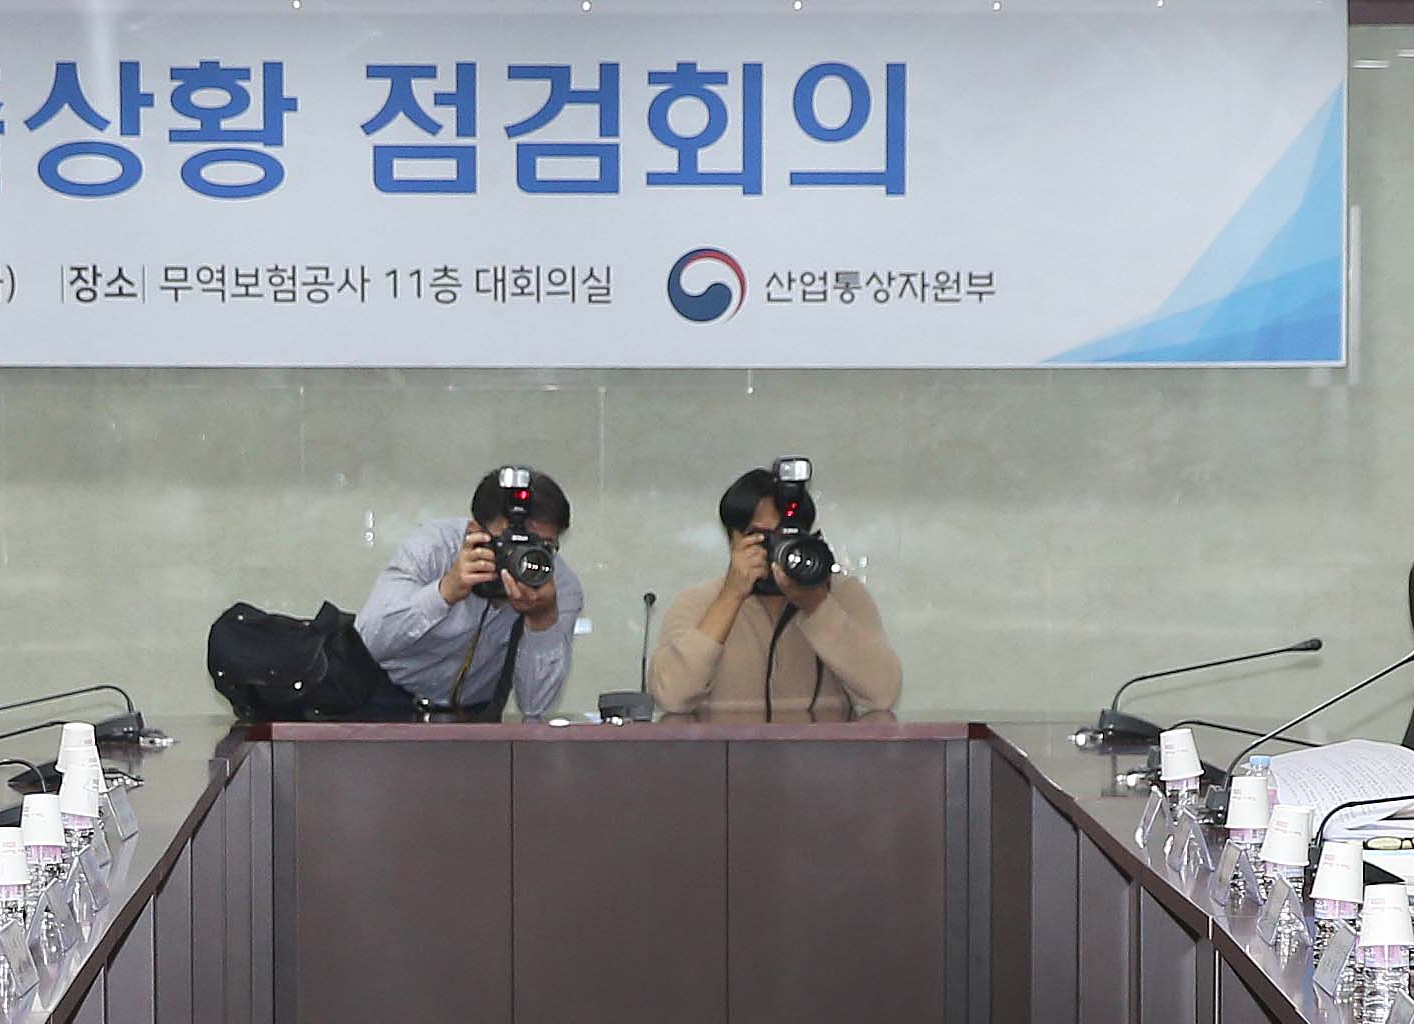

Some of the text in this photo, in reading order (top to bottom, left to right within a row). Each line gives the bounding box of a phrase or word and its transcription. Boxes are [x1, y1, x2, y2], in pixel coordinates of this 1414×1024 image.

[358, 60, 907, 196] 점검회의
[158, 264, 372, 304] 무역보험공사
[383, 264, 463, 304] 11층
[474, 264, 612, 305] 대회의실
[764, 269, 997, 305] 산업통상자원부
